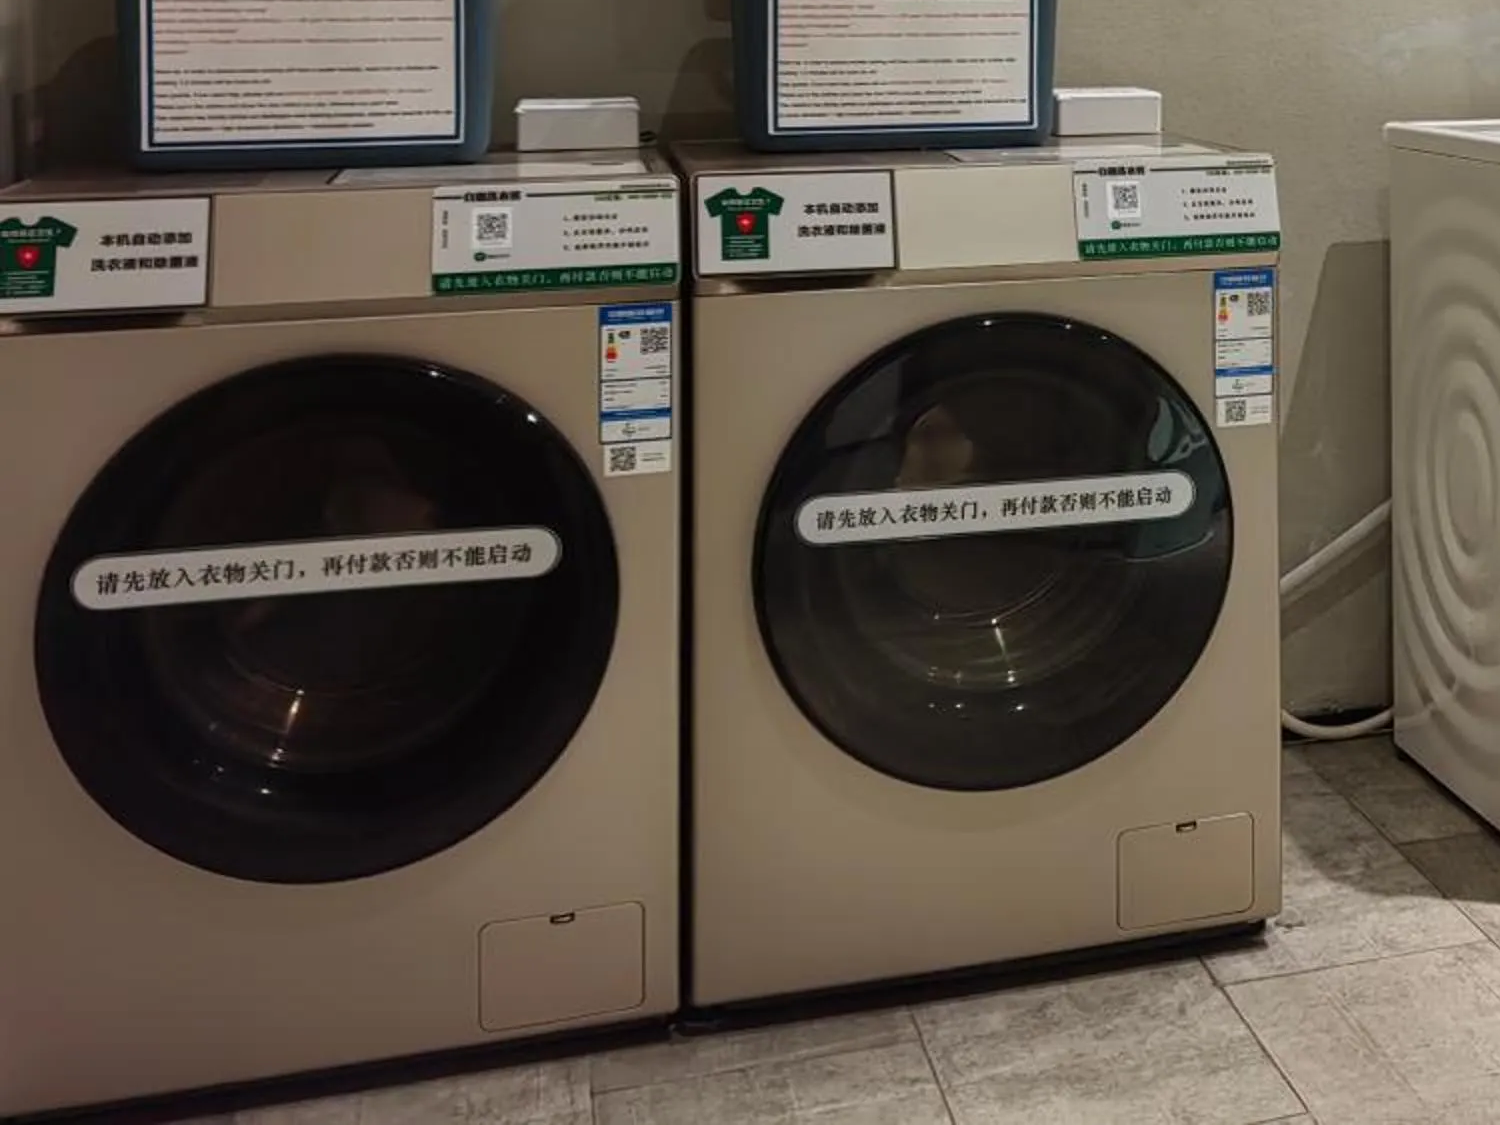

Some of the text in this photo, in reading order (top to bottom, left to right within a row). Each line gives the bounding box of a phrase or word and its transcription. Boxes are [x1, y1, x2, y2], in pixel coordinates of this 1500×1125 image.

[803, 202, 880, 216] 本机自动添加
[797, 223, 887, 238] 洗衣液和除菌液
[99, 231, 193, 248] 本机自动添加
[90, 255, 199, 272] 洗衣液和除菌液
[815, 485, 1173, 532] 请先放入衣物关门，再付款否则不能启动
[95, 542, 534, 596] 请先放入衣物关门，再付款否则不能启动
